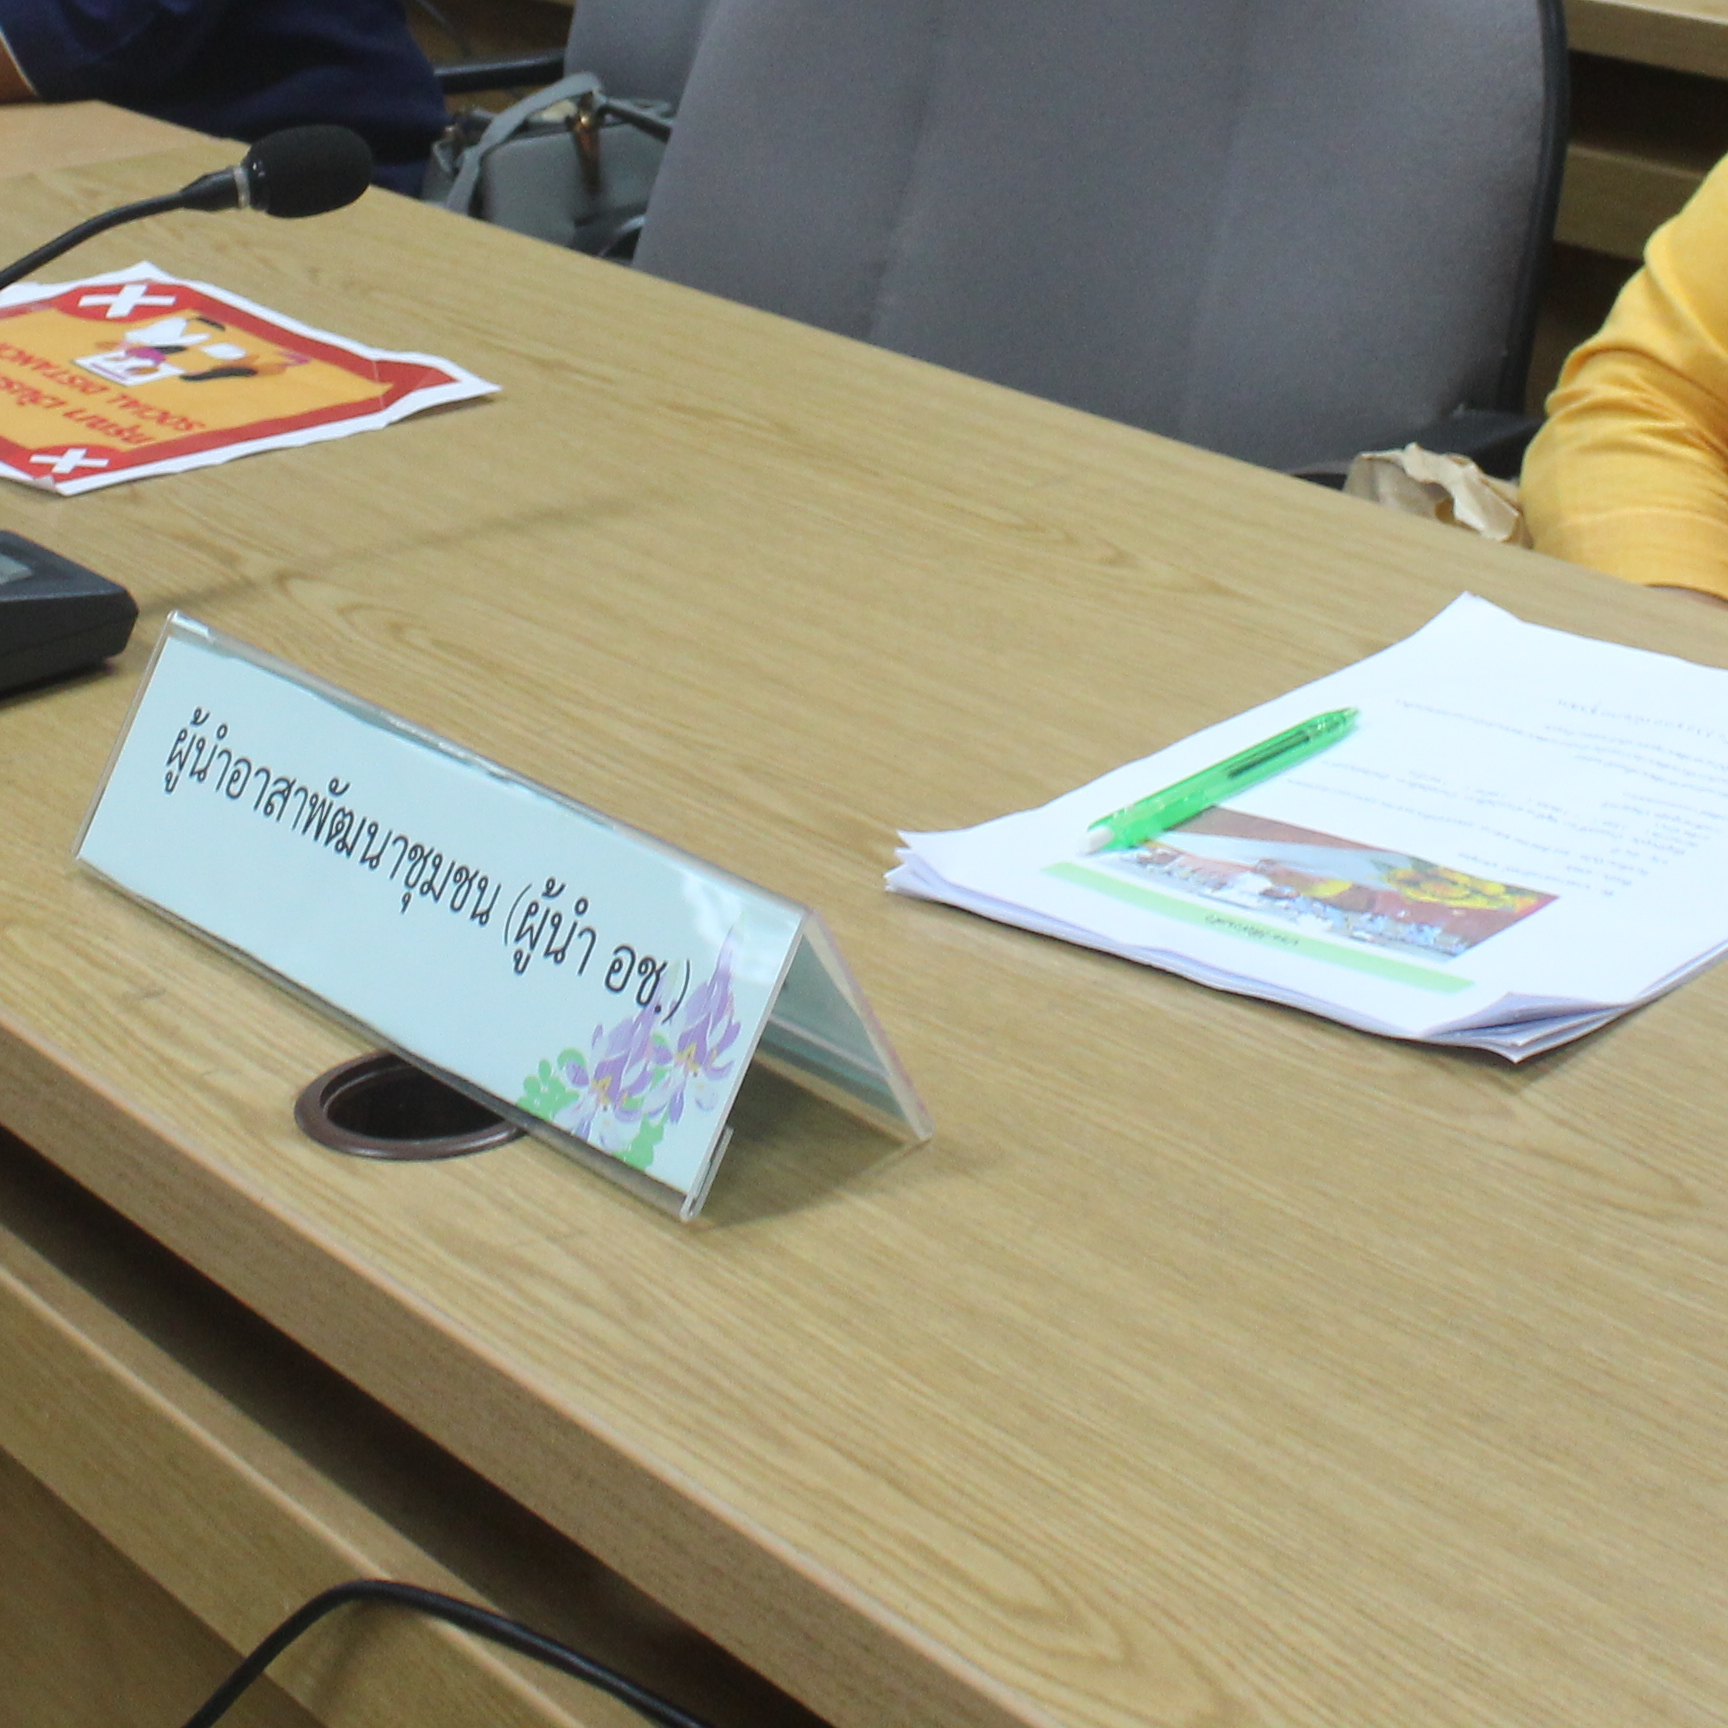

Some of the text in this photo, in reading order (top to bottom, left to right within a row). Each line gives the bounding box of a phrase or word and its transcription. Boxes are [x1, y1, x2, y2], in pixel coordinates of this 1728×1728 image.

[62, 408, 156, 444] กรุณา
[107, 393, 206, 431] SOCIAL
[164, 706, 691, 1025] ผู้นำอาสาพัฒนาชุมชน (ผู้นำ อช.)
